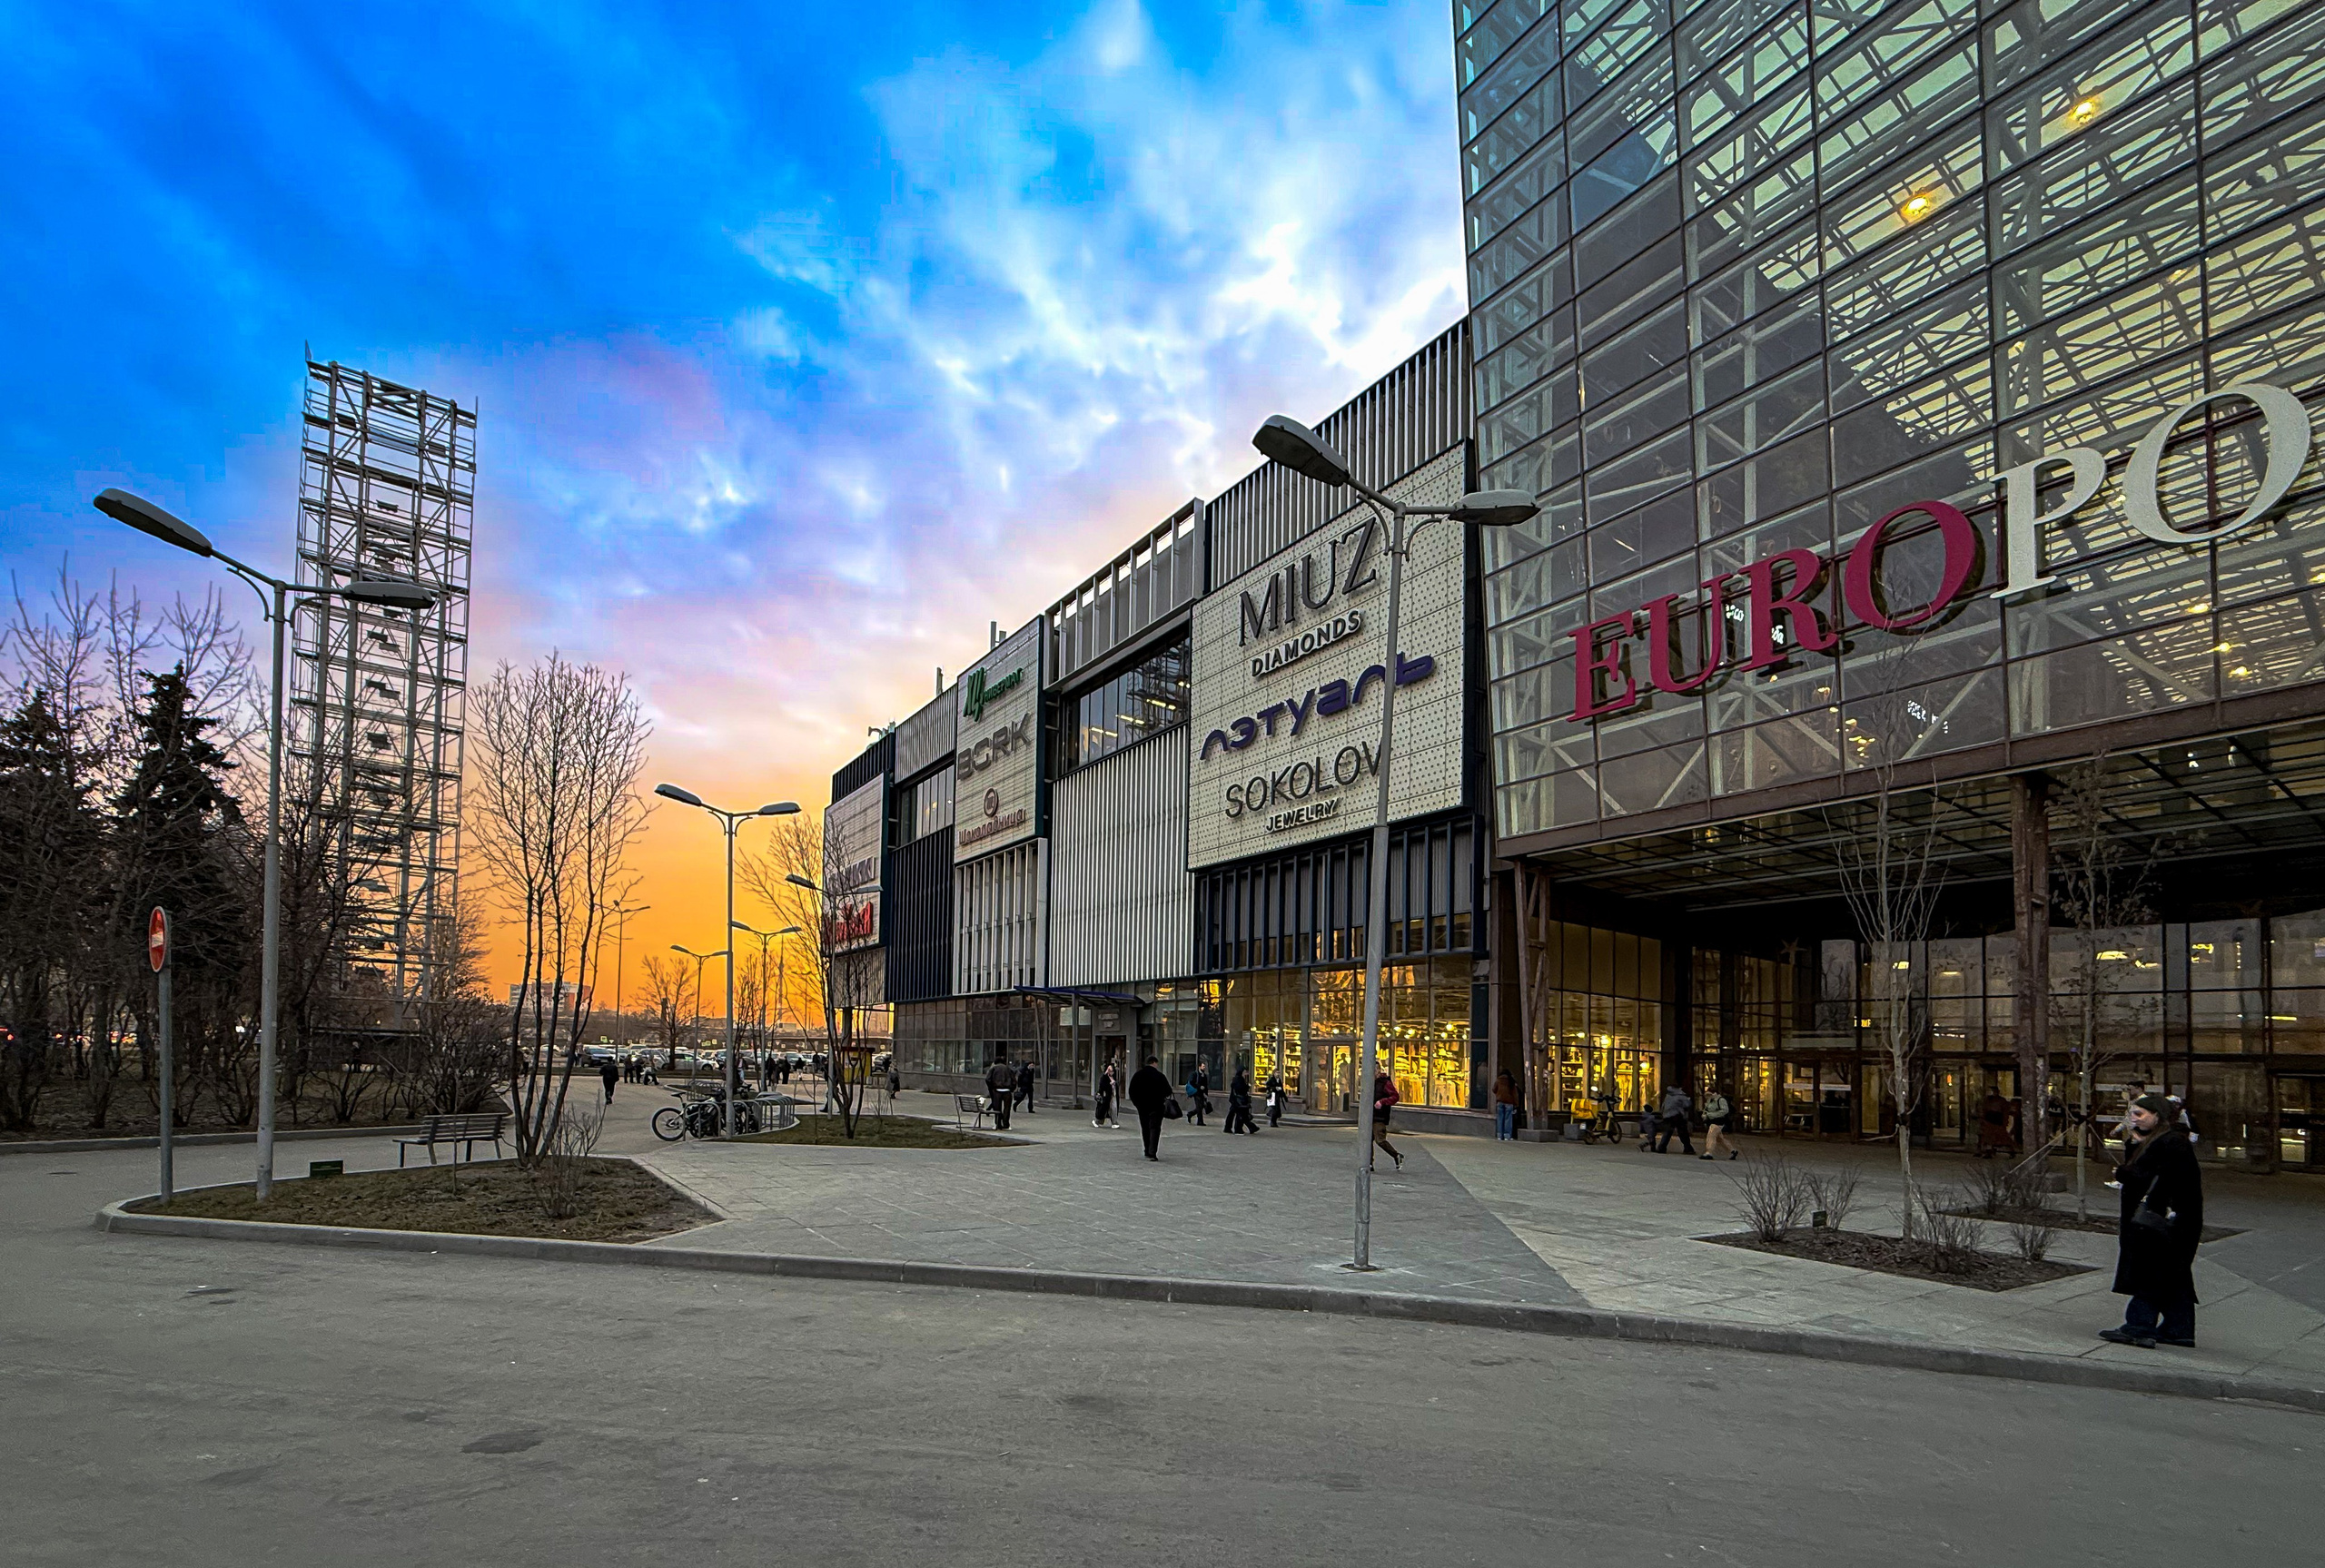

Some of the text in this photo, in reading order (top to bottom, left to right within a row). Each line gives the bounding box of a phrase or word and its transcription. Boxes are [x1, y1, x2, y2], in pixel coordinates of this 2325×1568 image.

[1238, 517, 1379, 647] MIUZ
[1566, 383, 2311, 723] EUROPO
[1251, 610, 1361, 679] DIAMONDS
[957, 712, 1032, 782] BORK
[1225, 737, 1385, 819] SOKOLOV
[958, 808, 1026, 845] Шоколадница
[1265, 798, 1337, 833] JEWELRY
